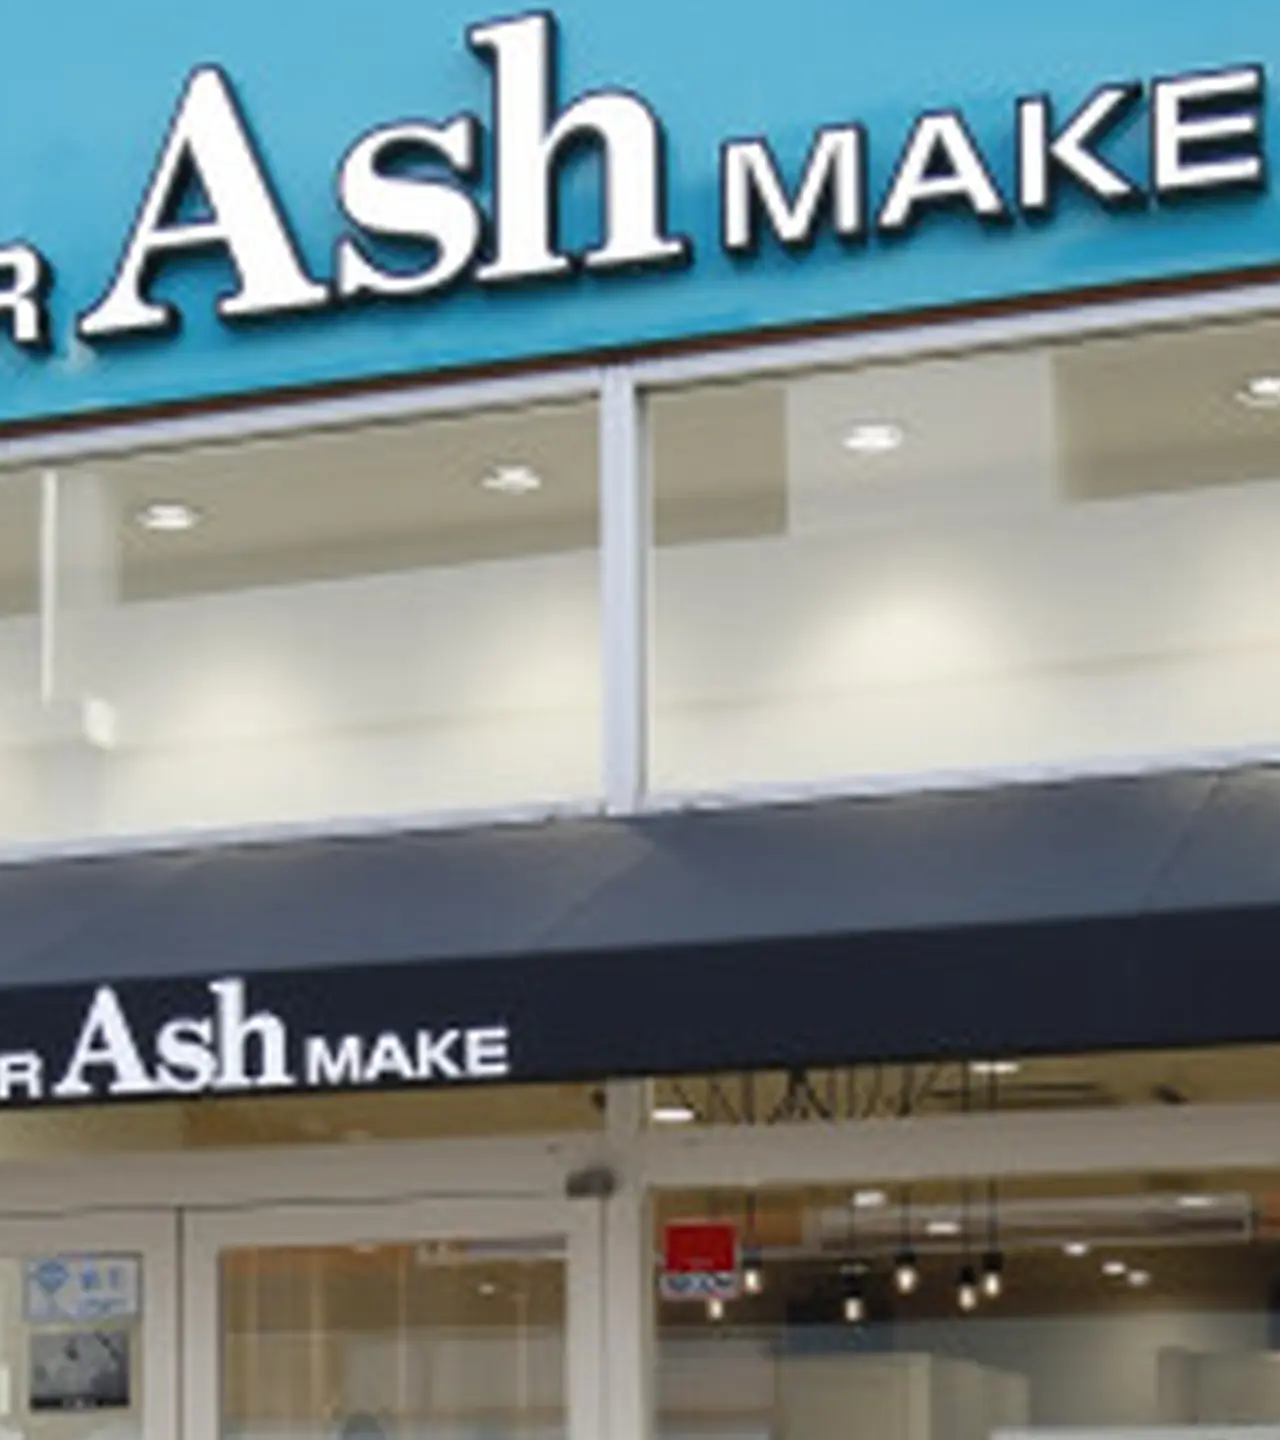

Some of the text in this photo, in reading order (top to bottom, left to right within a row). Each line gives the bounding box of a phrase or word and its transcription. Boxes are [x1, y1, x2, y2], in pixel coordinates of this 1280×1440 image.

[79, 12, 689, 340] Ash
[722, 66, 1264, 250] MAKE
[52, 978, 296, 1097] Ash
[304, 1027, 509, 1085] MAKE
